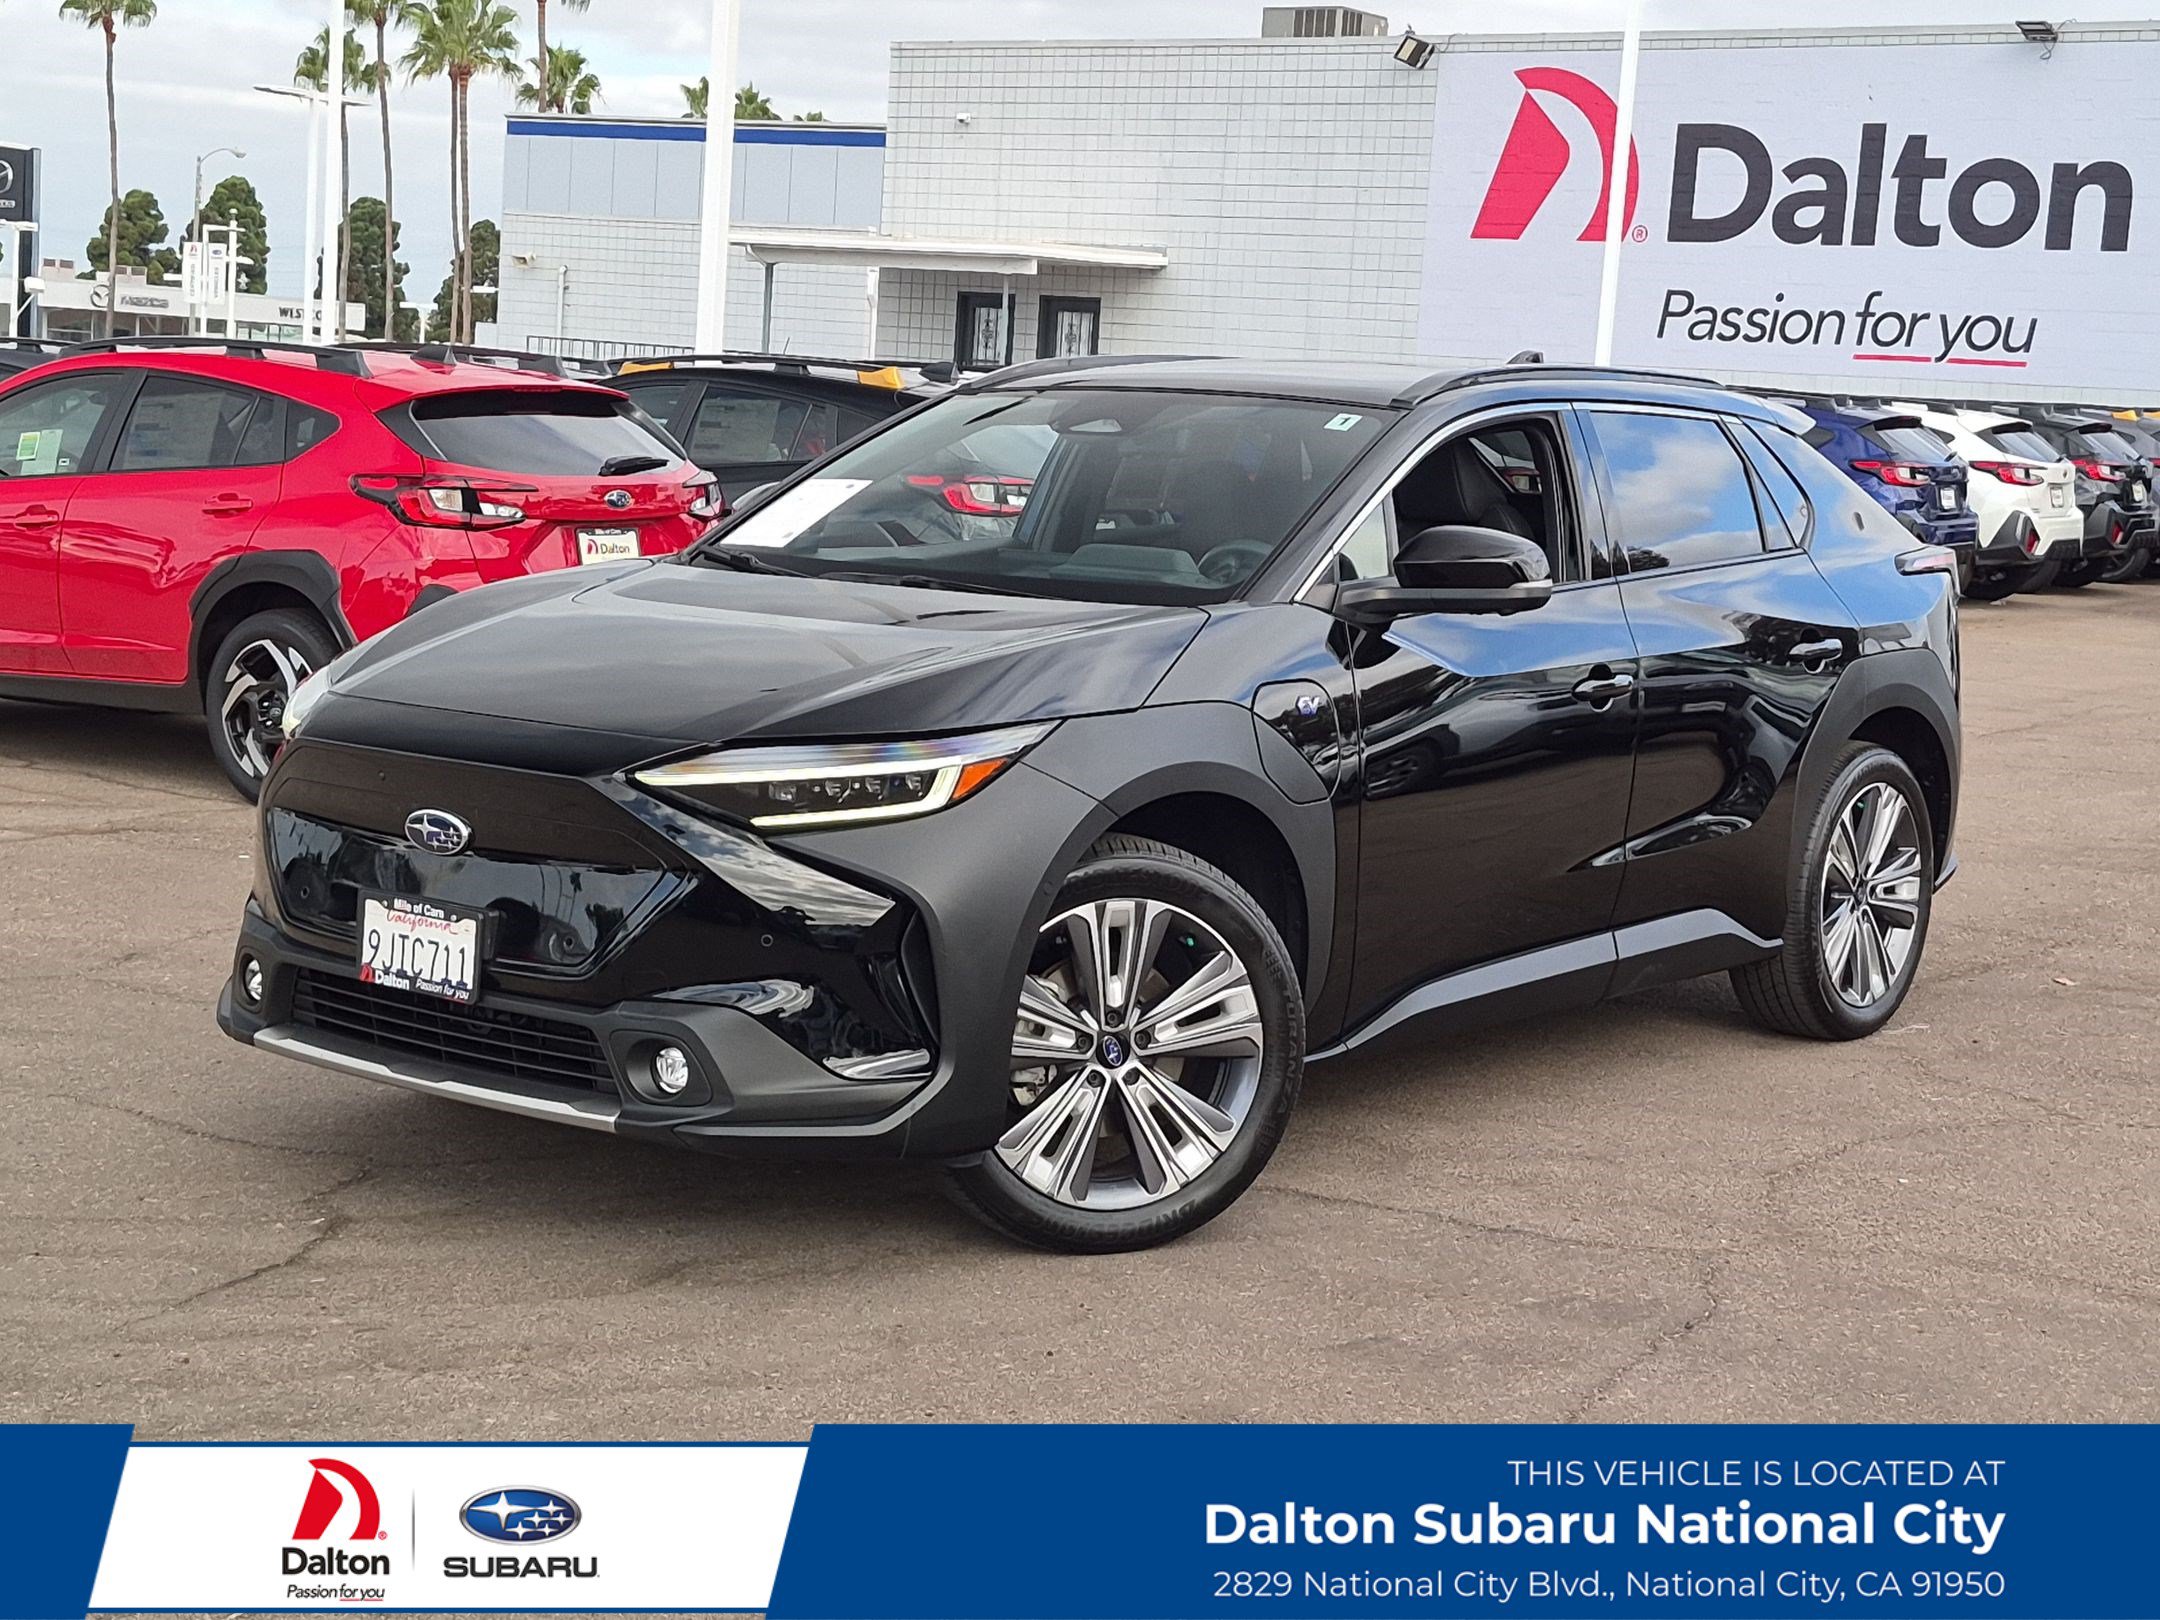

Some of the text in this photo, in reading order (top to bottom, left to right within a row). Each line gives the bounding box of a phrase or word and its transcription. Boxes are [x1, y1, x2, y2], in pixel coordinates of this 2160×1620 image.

[1667, 123, 2133, 252] Dalton
[1656, 289, 2038, 363] Passion for you
[413, 903, 423, 914] of
[375, 970, 410, 991] Dalton
[416, 978, 470, 1000] Passion for you
